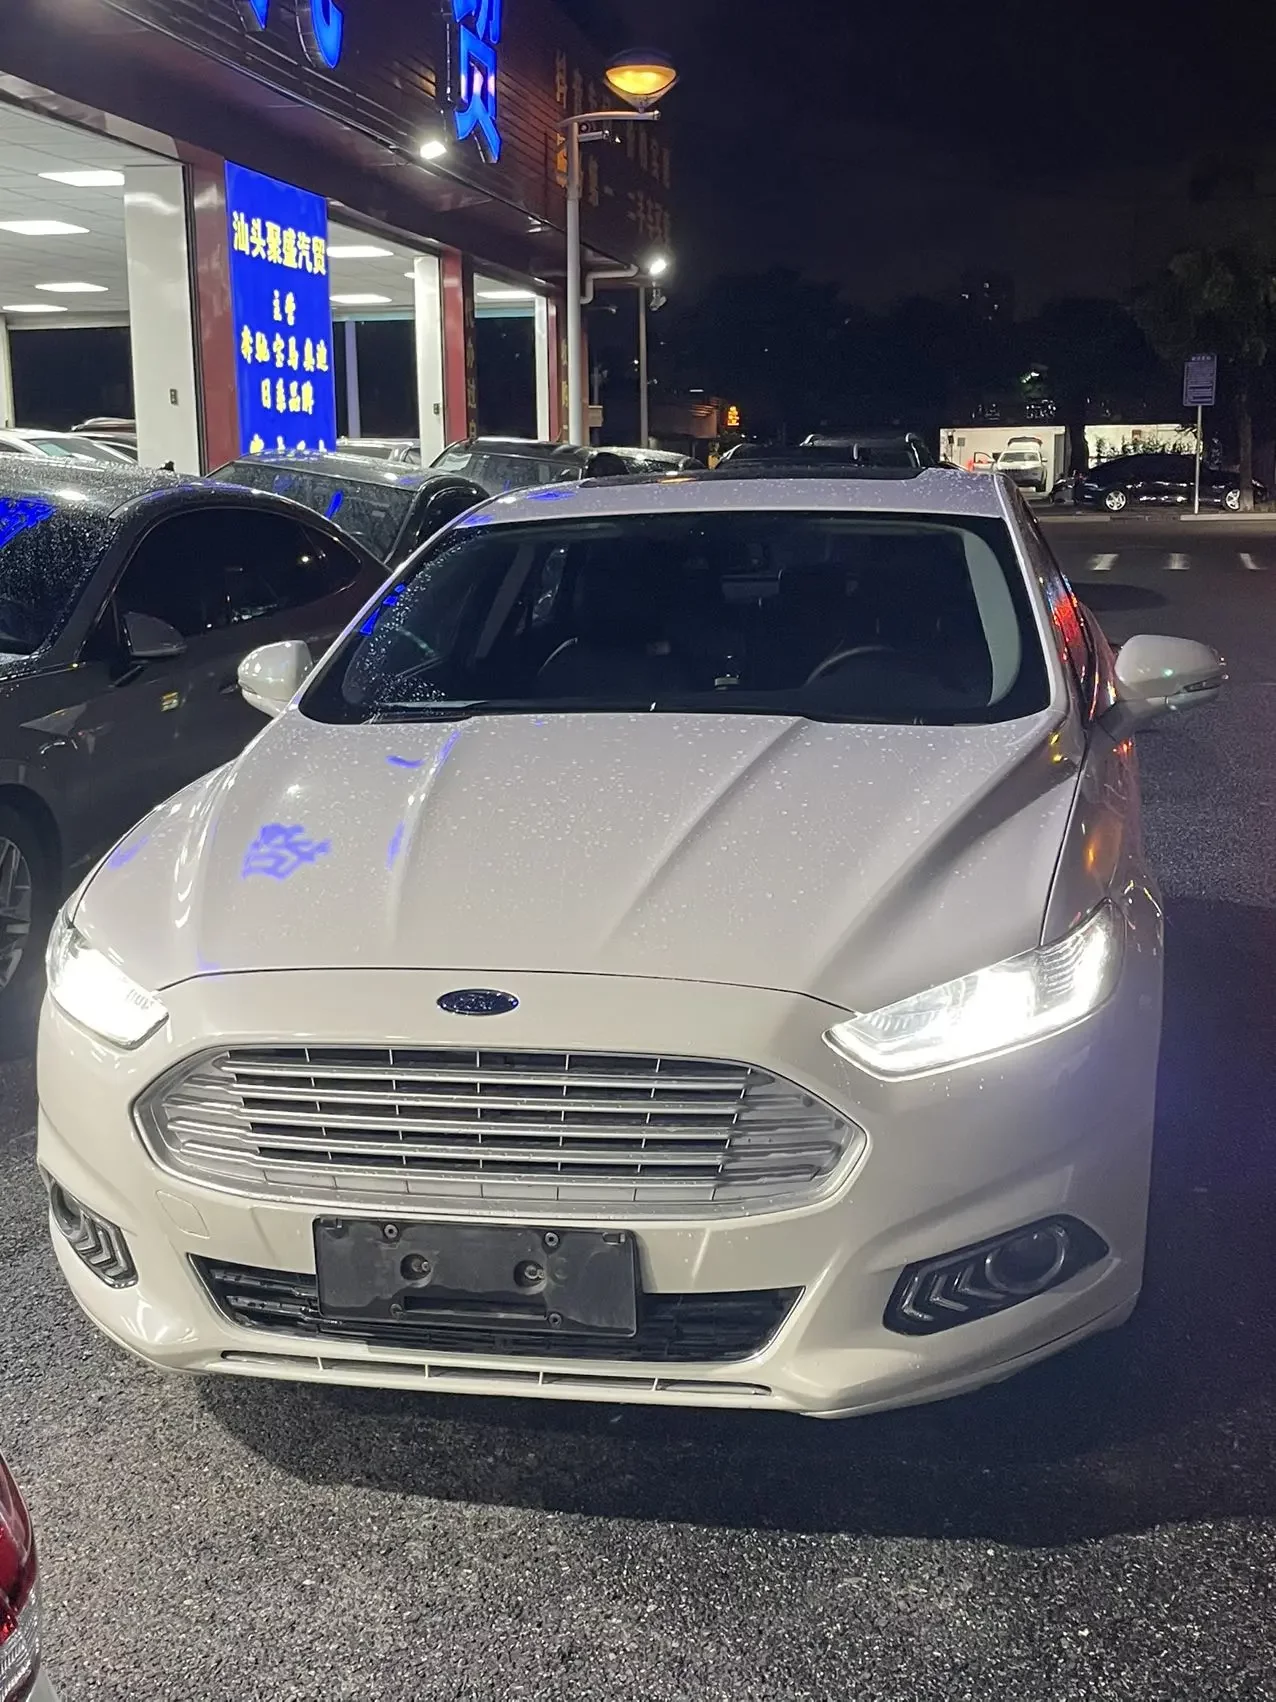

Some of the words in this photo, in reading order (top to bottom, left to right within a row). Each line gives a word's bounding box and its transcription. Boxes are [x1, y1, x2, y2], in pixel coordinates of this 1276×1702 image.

[232, 210, 327, 276] 汕头聚盛汽贸
